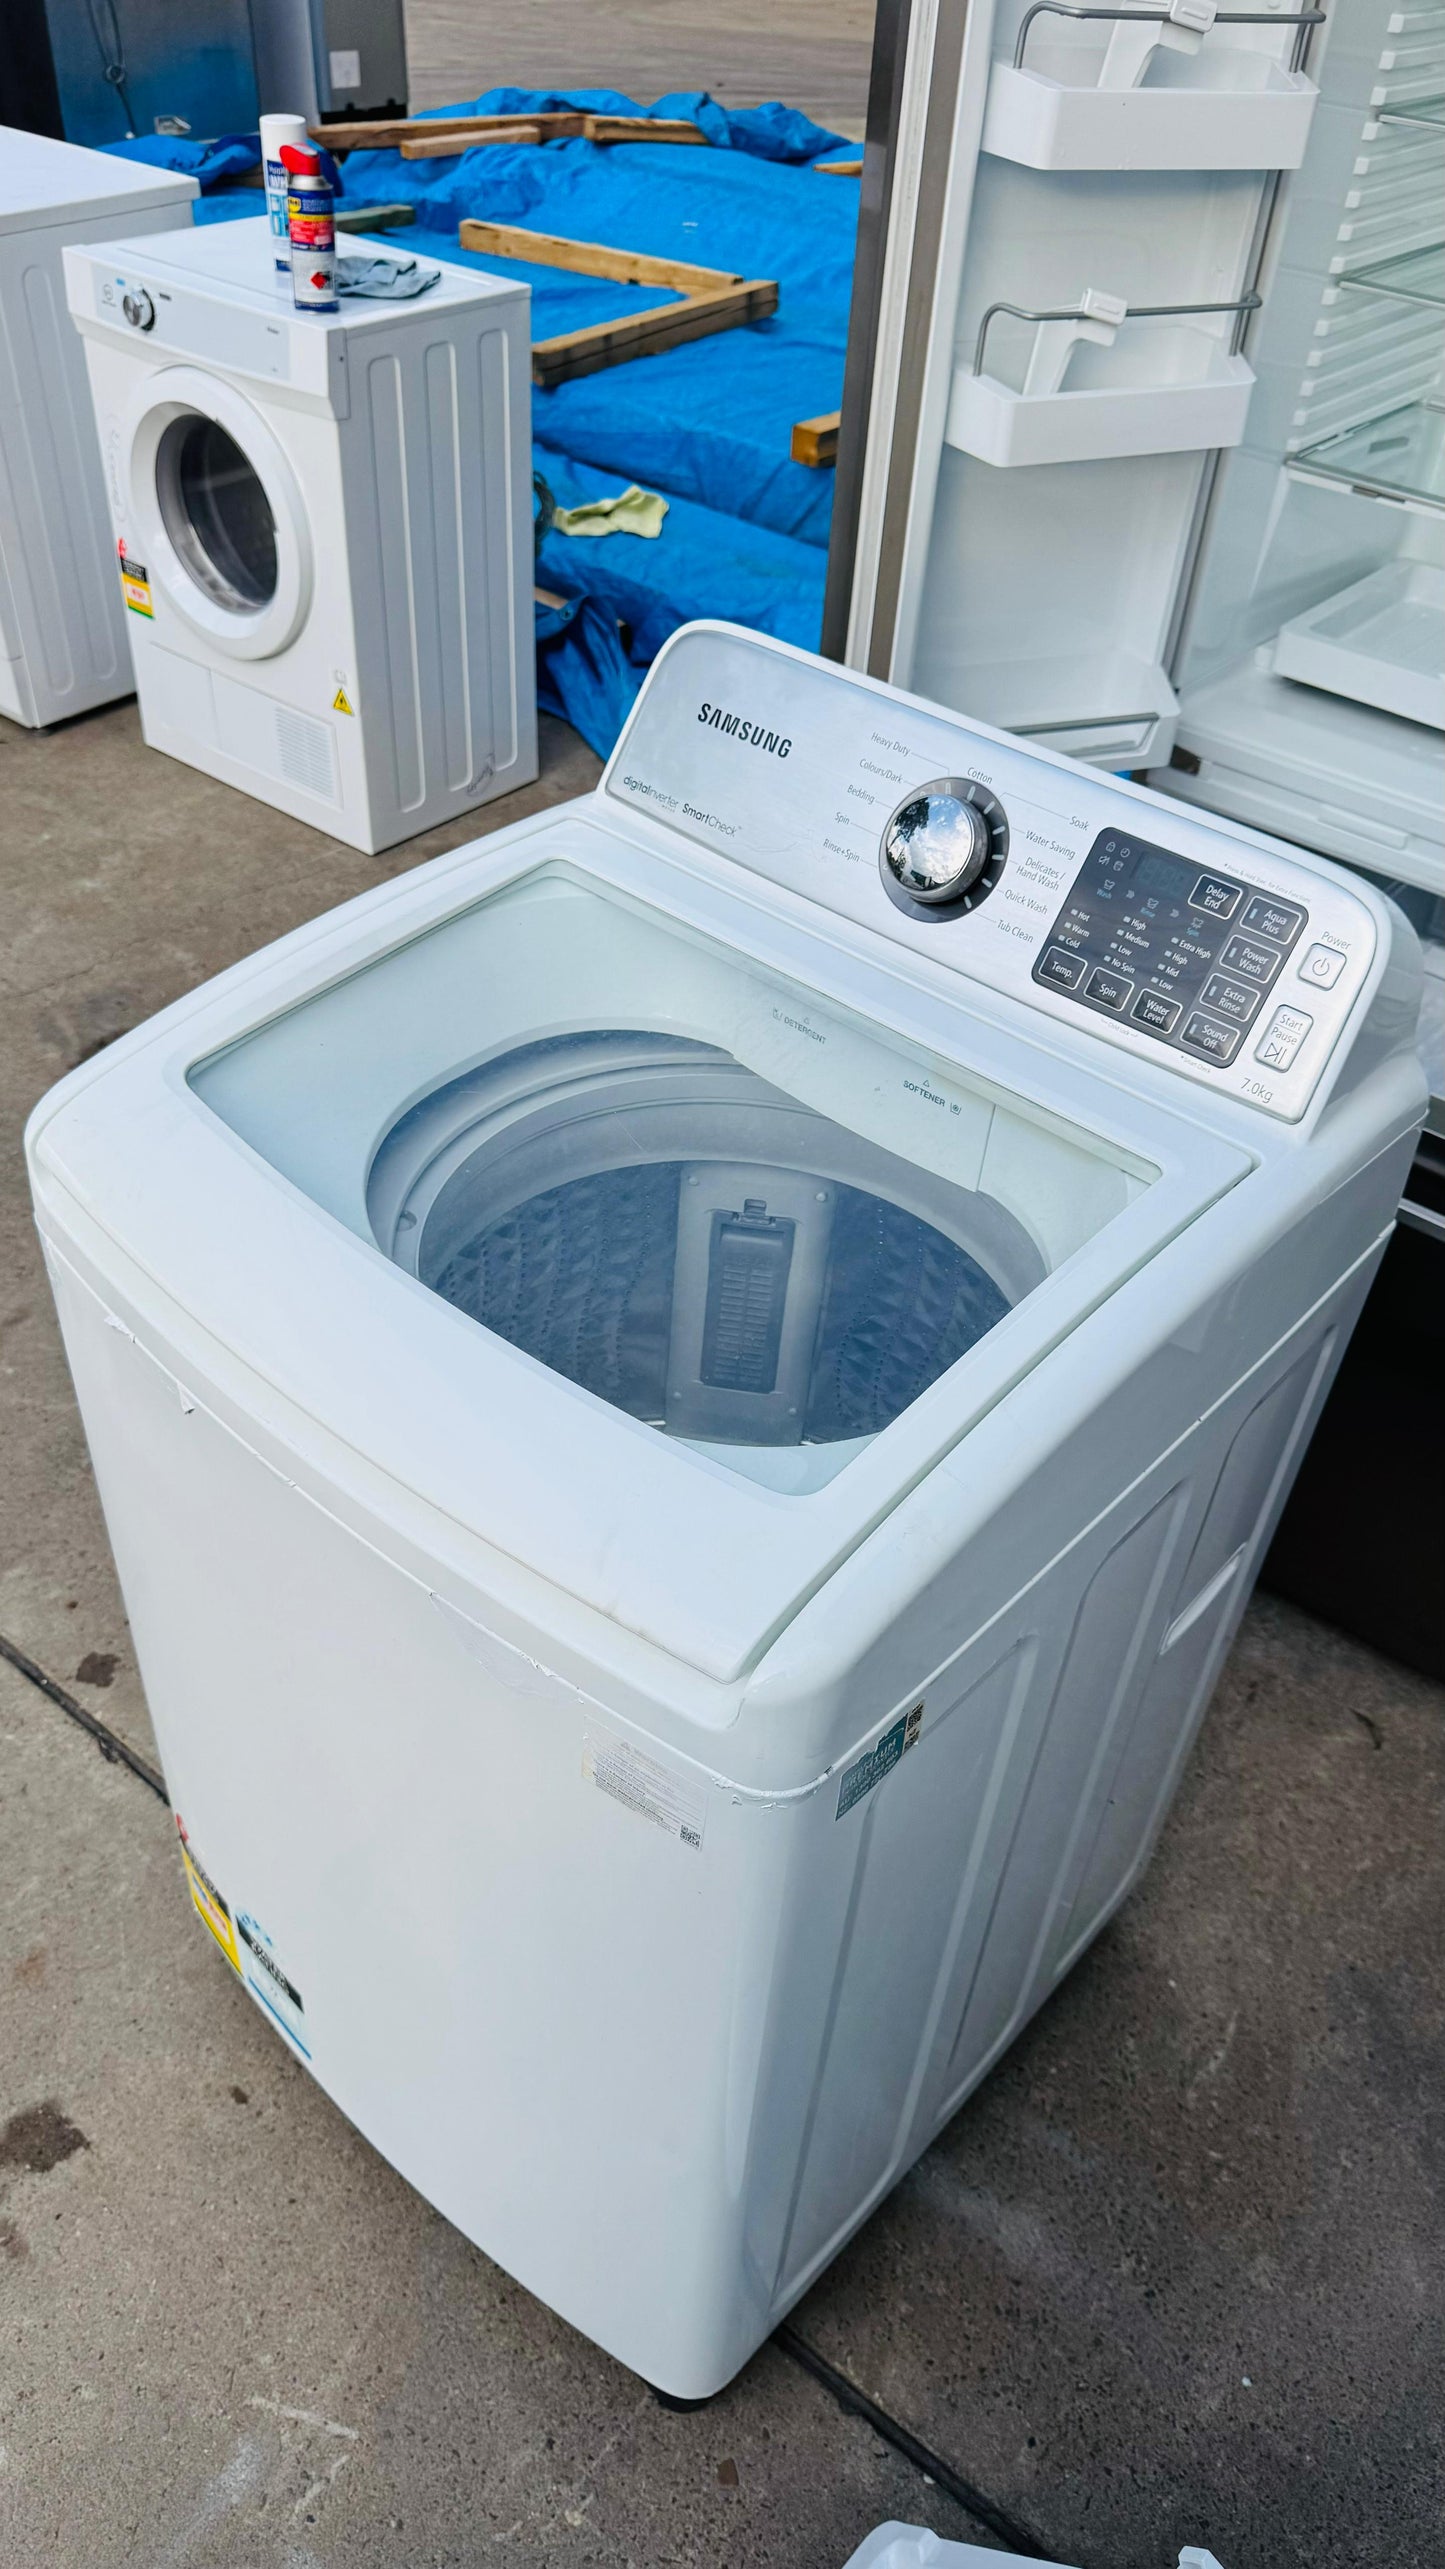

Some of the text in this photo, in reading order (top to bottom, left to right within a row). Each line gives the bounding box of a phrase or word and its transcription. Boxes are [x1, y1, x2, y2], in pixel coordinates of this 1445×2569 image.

[697, 703, 792, 758] SAMSUNG
[871, 732, 910, 757] Heavy Duty
[859, 758, 903, 783] Colours/Dark
[967, 766, 993, 784] Cotton
[847, 784, 875, 805] Bedding
[834, 811, 849, 826] Spin
[1069, 816, 1090, 831] Soak
[823, 838, 860, 862] Rinse+Spin
[1025, 830, 1076, 861] Water Saving
[1025, 857, 1059, 879] Delicates
[1015, 865, 1060, 891] Hand Wash
[1004, 889, 1048, 915] Quick Wash
[1206, 884, 1230, 903] Delay
[1204, 896, 1221, 910] End
[1077, 911, 1091, 923] Hot
[1131, 918, 1147, 931] High
[1264, 909, 1288, 926] Aqua
[997, 919, 1034, 943] Tub Clean
[1072, 924, 1091, 938] Warm
[1261, 920, 1280, 935] Plus
[1065, 937, 1081, 949] Cold
[1124, 931, 1150, 948] Medium
[1322, 931, 1351, 950] Power
[1117, 944, 1133, 956] Low
[1178, 939, 1212, 960] Extra High
[1242, 947, 1269, 965] Power
[1111, 957, 1136, 975] No Spin
[1172, 952, 1188, 965] High
[1238, 958, 1262, 975] Wash
[1051, 961, 1073, 979] Temp.
[1165, 964, 1180, 977] Mid
[1099, 983, 1117, 998] Spin
[1159, 977, 1174, 991] Low
[1223, 987, 1246, 1003] Extra
[1146, 999, 1170, 1016] Water
[1218, 998, 1241, 1014] Rinse
[1143, 1009, 1165, 1024] Level
[1279, 1014, 1304, 1031] Start
[784, 1016, 827, 1045] DETERGENT
[1202, 1024, 1229, 1042] Sound
[1270, 1027, 1298, 1046] Pause
[1203, 1037, 1219, 1050] Off
[903, 1080, 946, 1107] SOFTENER
[1240, 1077, 1274, 1104] 7.0kg
